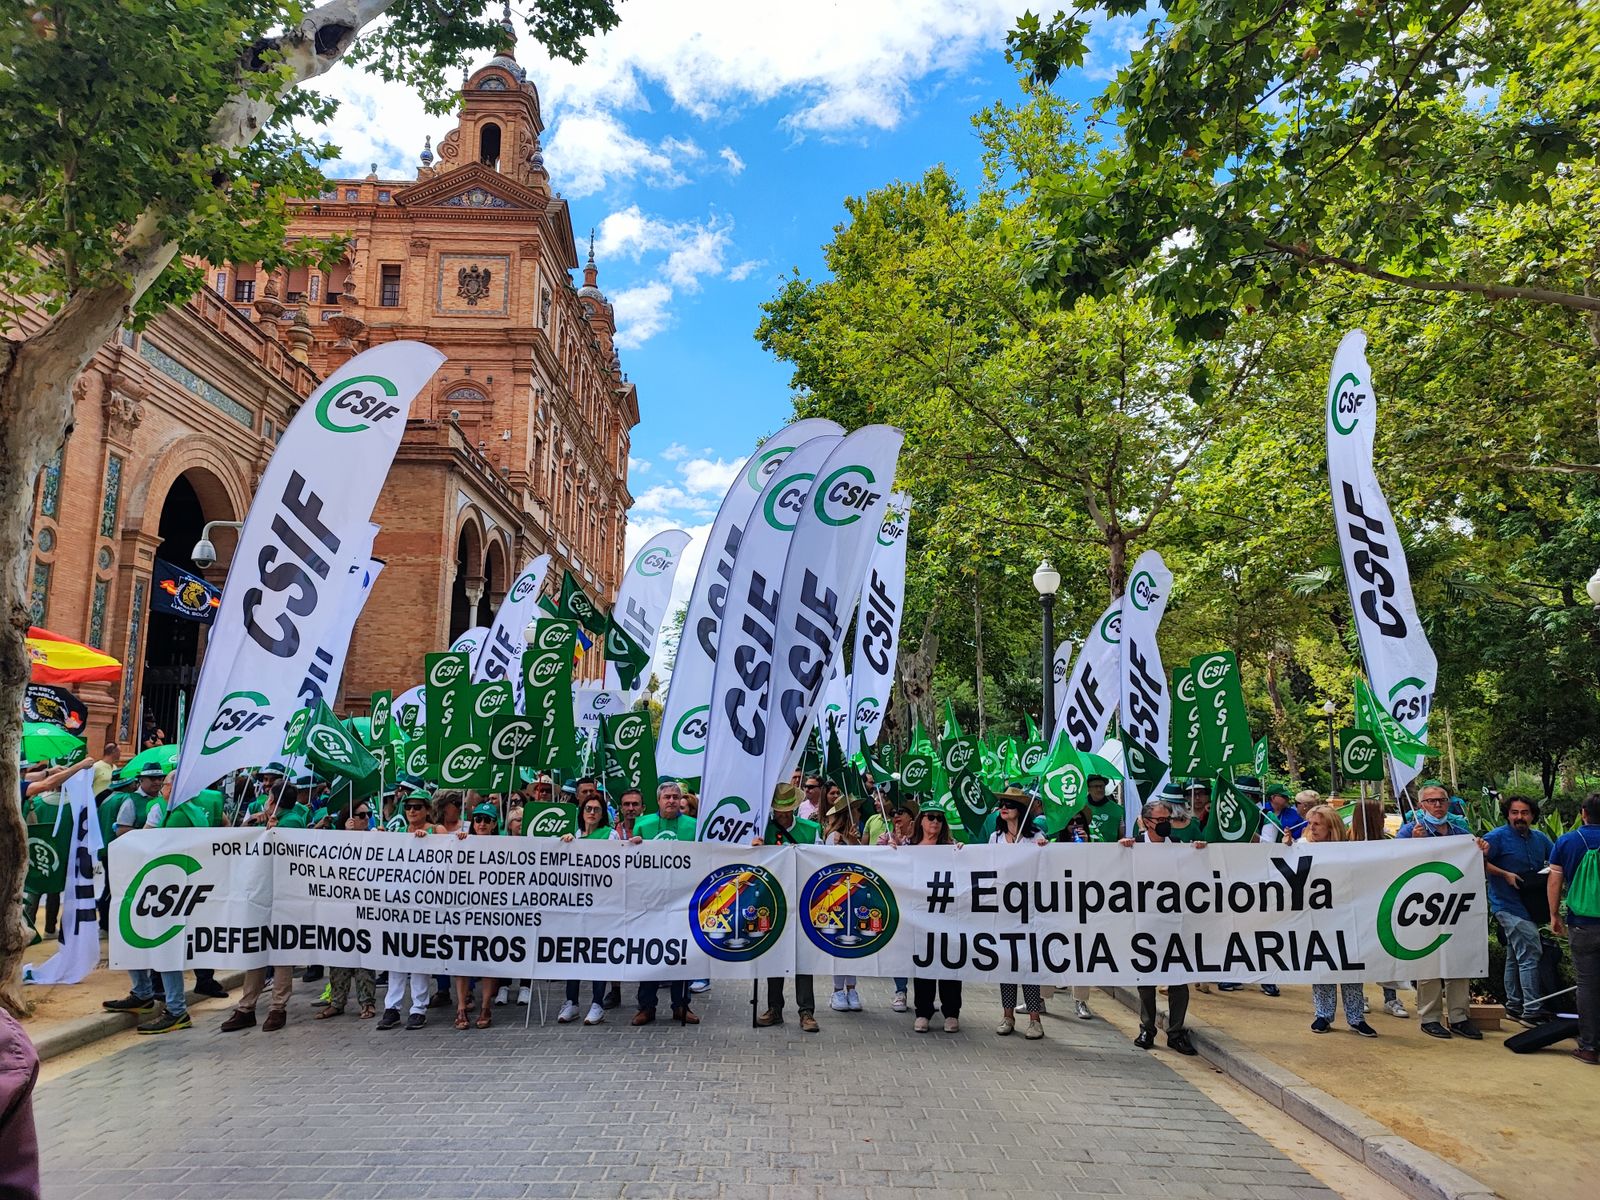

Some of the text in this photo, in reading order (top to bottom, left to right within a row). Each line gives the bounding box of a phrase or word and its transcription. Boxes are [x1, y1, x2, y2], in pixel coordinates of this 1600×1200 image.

[334, 390, 400, 423] CSIF
[778, 488, 802, 512] CS
[828, 482, 881, 512] CSIF
[882, 522, 904, 538] CSIF
[242, 469, 342, 658] CSIF
[644, 554, 673, 570] CSIF
[1342, 480, 1408, 638] CSIF
[517, 582, 535, 594] CSIF
[171, 603, 190, 614] LUCHA
[573, 598, 592, 618] CSIF
[862, 568, 896, 675] CSIF
[546, 631, 572, 642] CSIF
[458, 644, 477, 654] CSIF
[479, 624, 514, 684] SIF
[437, 665, 464, 677] CSIF
[536, 662, 564, 676] CSIF
[1204, 664, 1231, 678] CSIF
[481, 694, 508, 707] CSIF
[1066, 662, 1105, 750] SIF
[211, 708, 275, 732] CSIF
[442, 690, 455, 737] CSI
[856, 707, 880, 724] CSIF
[1214, 690, 1234, 761] CSIF
[543, 689, 559, 765] CSIF
[620, 725, 646, 739] CSIF
[683, 718, 707, 739] CS
[317, 731, 351, 764] CSIF
[501, 733, 536, 747] CSIF
[1186, 706, 1200, 773] CSIF
[412, 754, 426, 766] CS
[450, 755, 486, 770] CSIF
[952, 748, 974, 762] CSIF
[1349, 748, 1376, 762] CSIF
[629, 751, 640, 788] CS
[908, 767, 928, 778] CSIF
[1220, 787, 1238, 828] CSIF
[536, 819, 569, 832] CSIF
[706, 815, 754, 843] CSIF
[35, 844, 48, 877] CSIF
[212, 842, 691, 870] POR LA DIGNIFICACIÓN DE LA LABOR DE LAS/LOS EMPLEADOS PÚBLICOS
[289, 862, 613, 888] POR LA RECUPERACIÓN DEL PODER ADQUISITIVO
[136, 884, 214, 918] CSIF
[308, 883, 594, 907] MEJORA DE LAS CONDICIONES LABORALES
[926, 855, 1333, 924] # EquiparacionYa
[356, 906, 542, 927] MEJORA DE LAS PENSIONES
[1397, 892, 1476, 927] CSIF
[186, 924, 688, 965] ¡DEFENDEMOS NUESTROS DERECHOS!
[912, 930, 1365, 972] JUSTICIA SALARIAL
